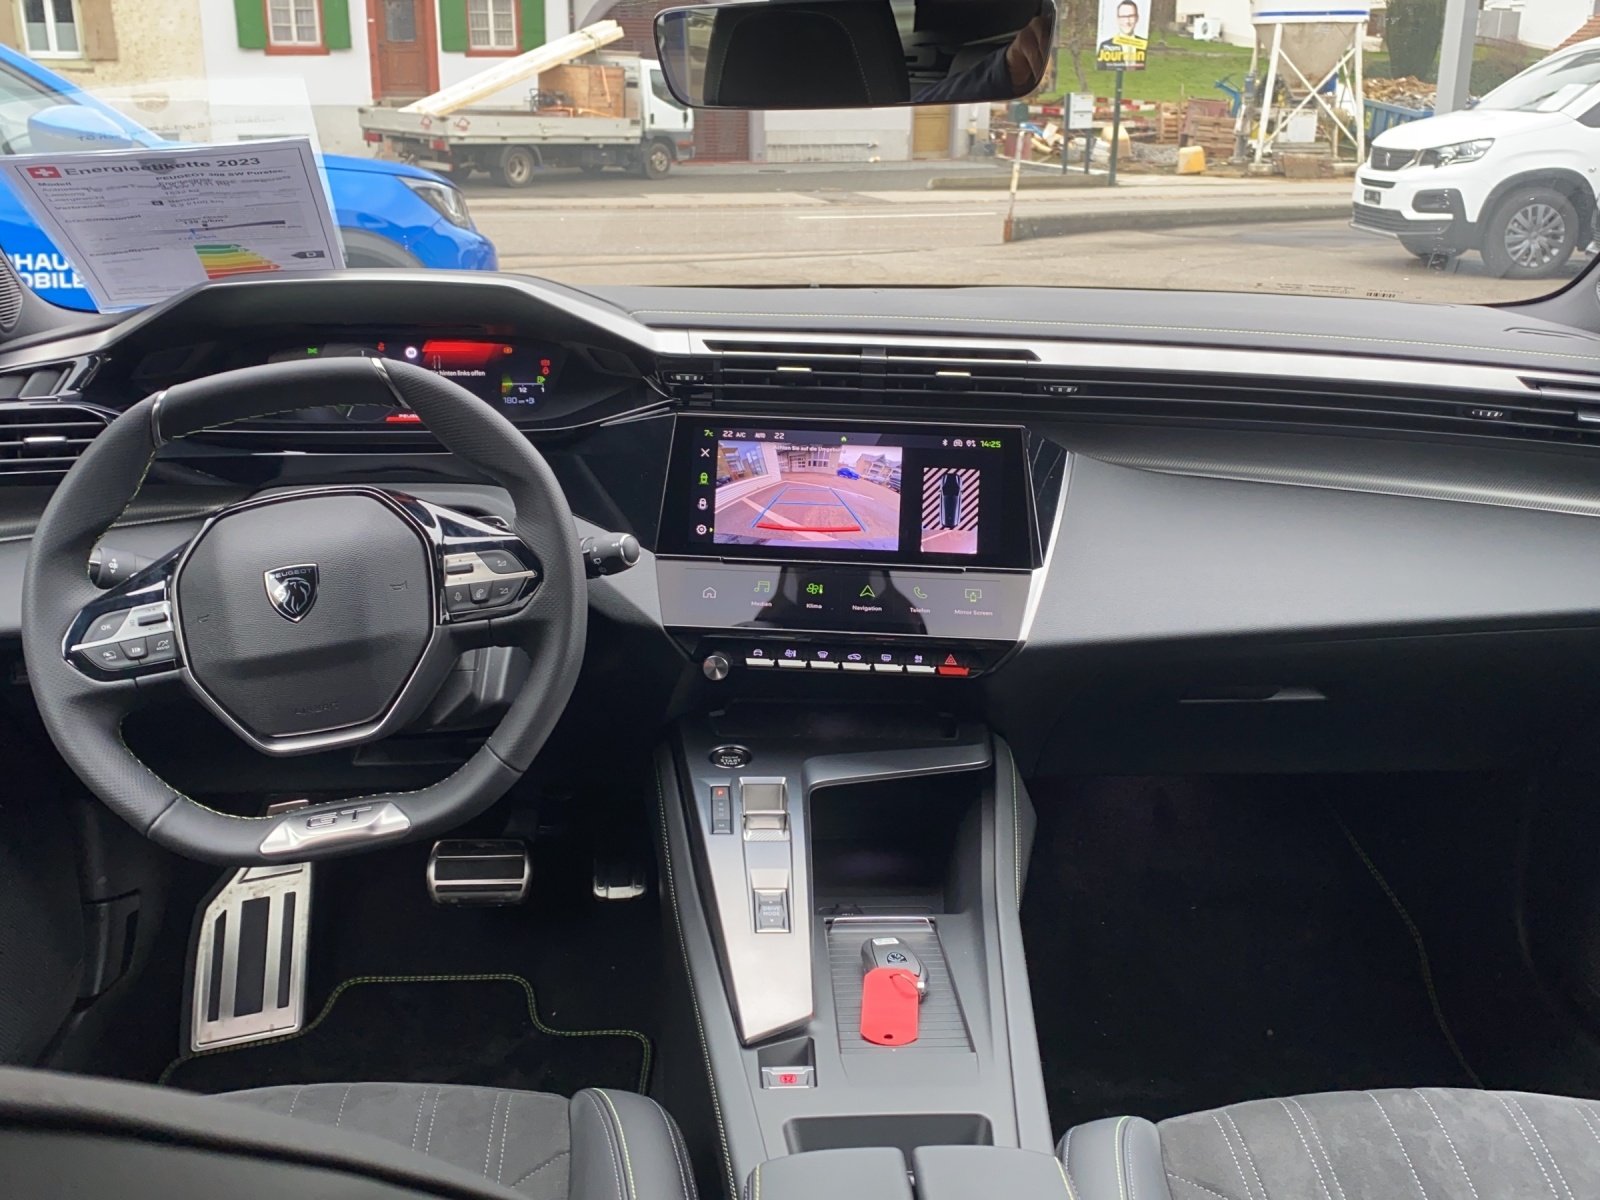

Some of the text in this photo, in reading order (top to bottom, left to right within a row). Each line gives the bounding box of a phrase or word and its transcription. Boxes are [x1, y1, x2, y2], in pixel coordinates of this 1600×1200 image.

[216, 157, 261, 168] 2023
[156, 172, 205, 181] PEUGEOT
[503, 396, 518, 404] 180
[773, 432, 785, 440] 22
[980, 440, 1002, 448] 14:25
[852, 604, 883, 612] Navigation
[954, 608, 972, 616] Mirror
